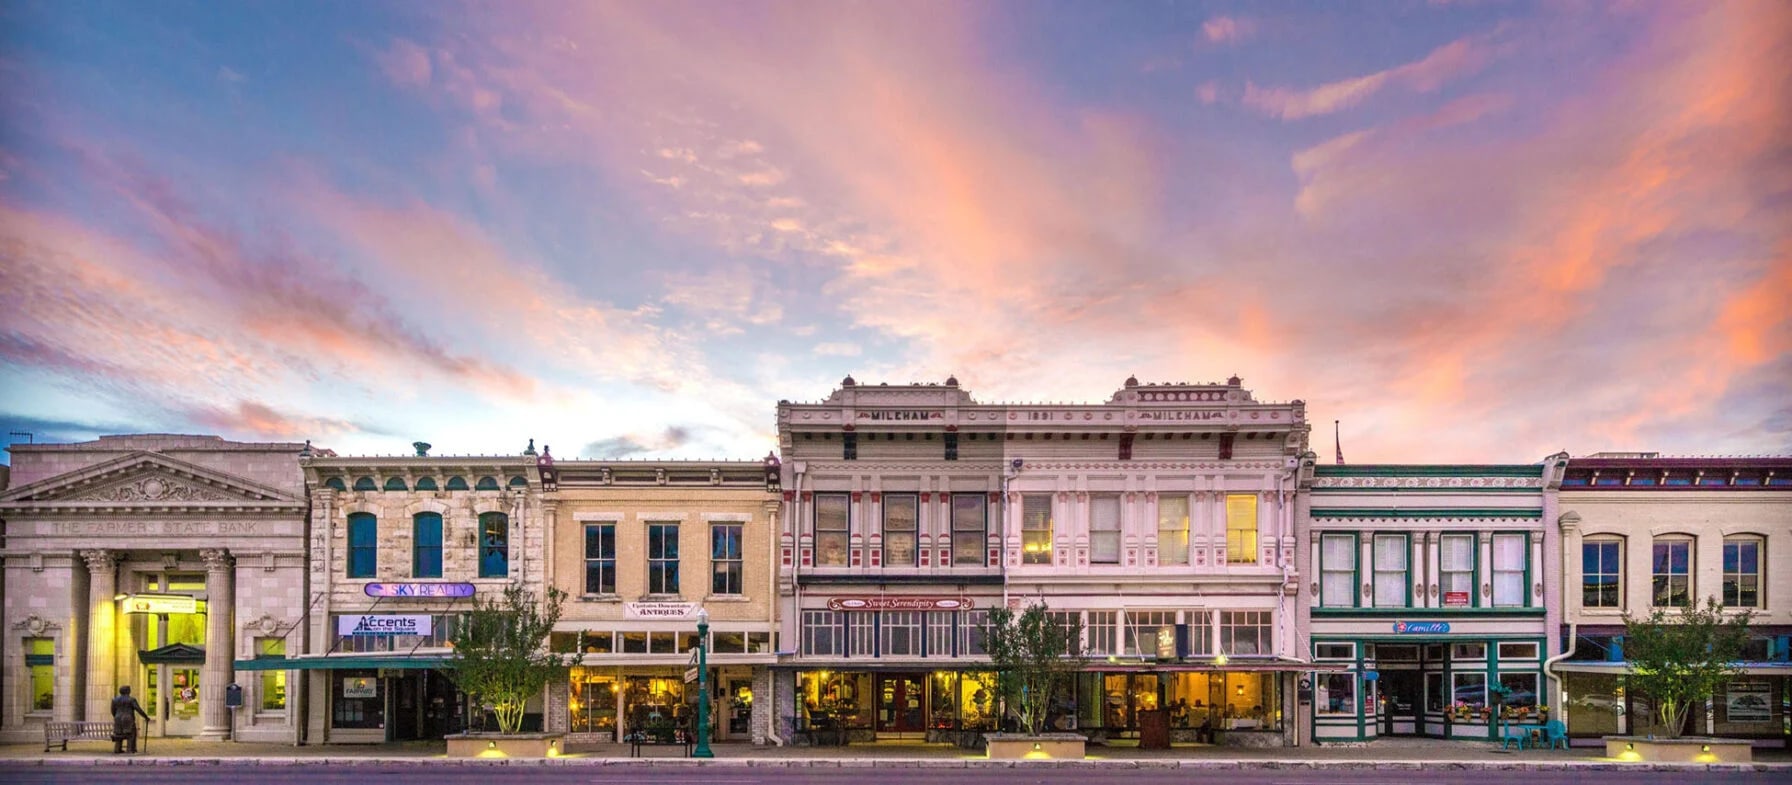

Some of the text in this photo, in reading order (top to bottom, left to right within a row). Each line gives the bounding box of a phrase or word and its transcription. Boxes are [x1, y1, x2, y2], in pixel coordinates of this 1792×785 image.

[871, 411, 930, 421] MILEHAM
[1028, 412, 1054, 421] 1891
[1153, 411, 1211, 421] MILEHAM
[53, 522, 257, 533] THE FARMERS STATE BANK
[865, 599, 890, 609] Sweet
[890, 599, 934, 609] Serendipity
[640, 608, 685, 616] ANTIQUES
